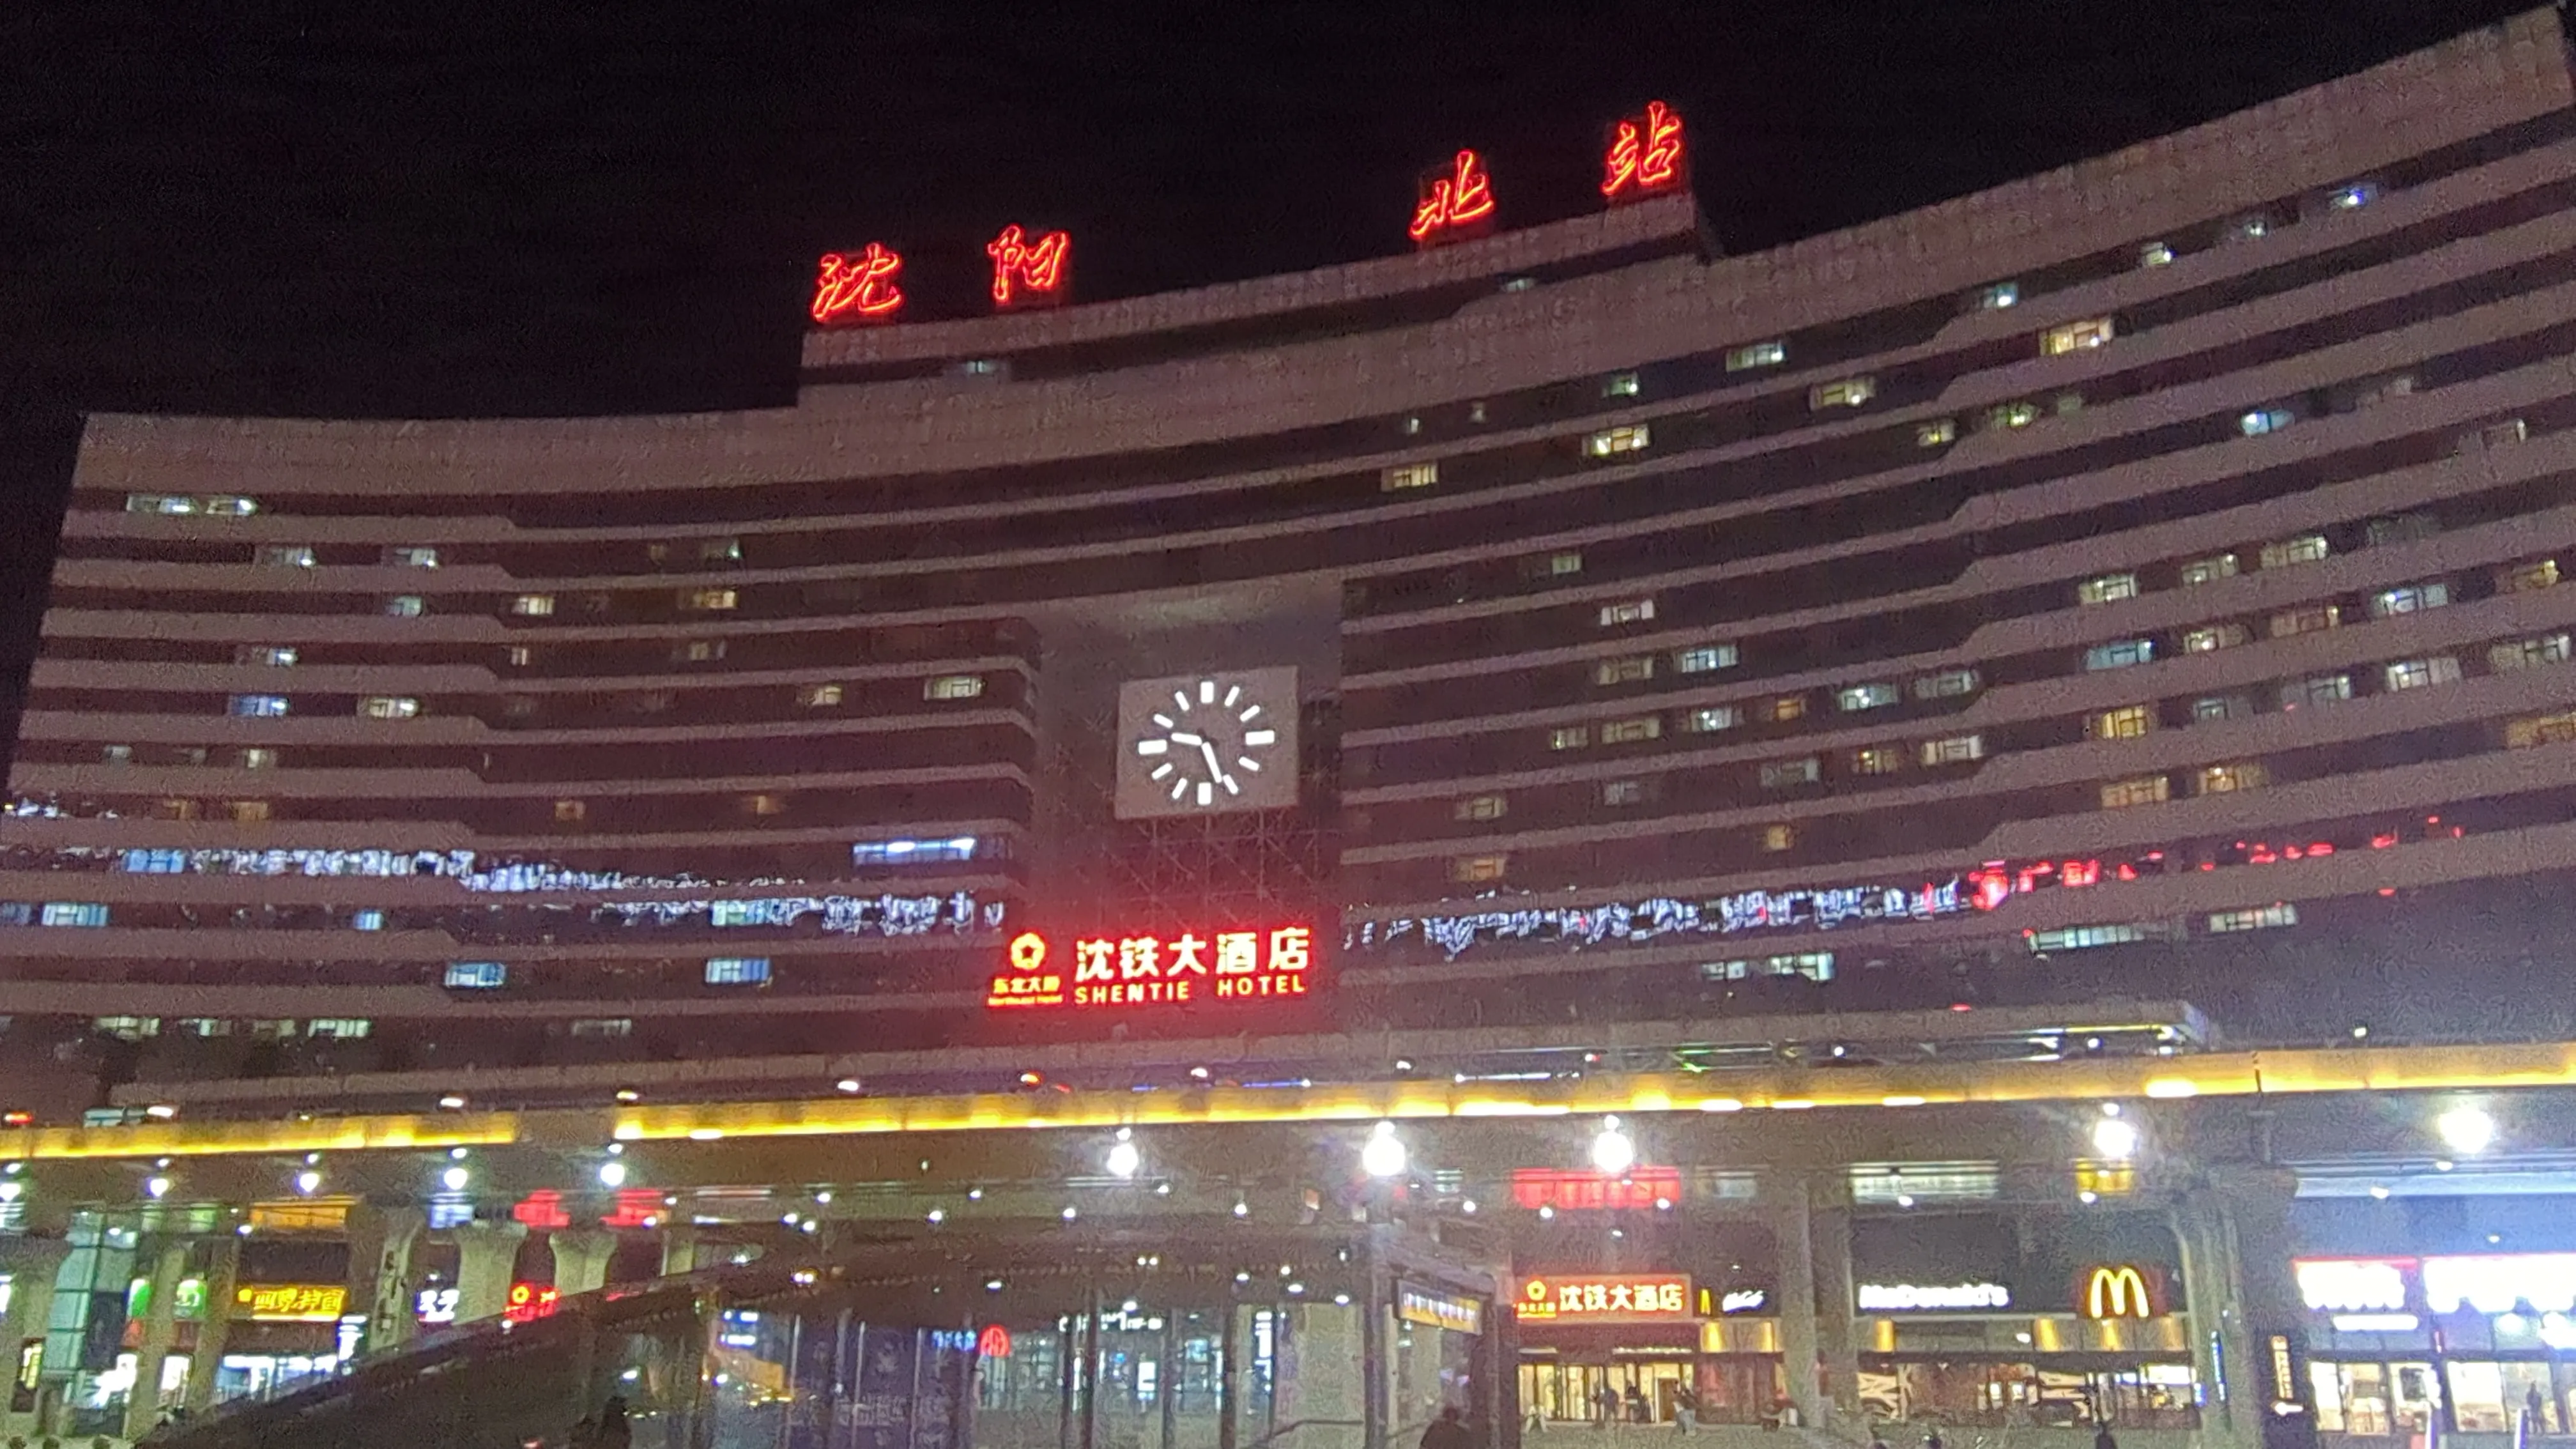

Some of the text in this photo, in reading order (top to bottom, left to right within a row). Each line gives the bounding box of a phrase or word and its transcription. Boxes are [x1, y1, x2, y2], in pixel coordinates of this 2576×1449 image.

[1075, 926, 1310, 981] 沈铁大酒店
[1075, 980, 1190, 1004] SHENTIE
[1217, 974, 1306, 997] HOTEL
[1559, 1284, 1683, 1312] 沈铁大酒店
